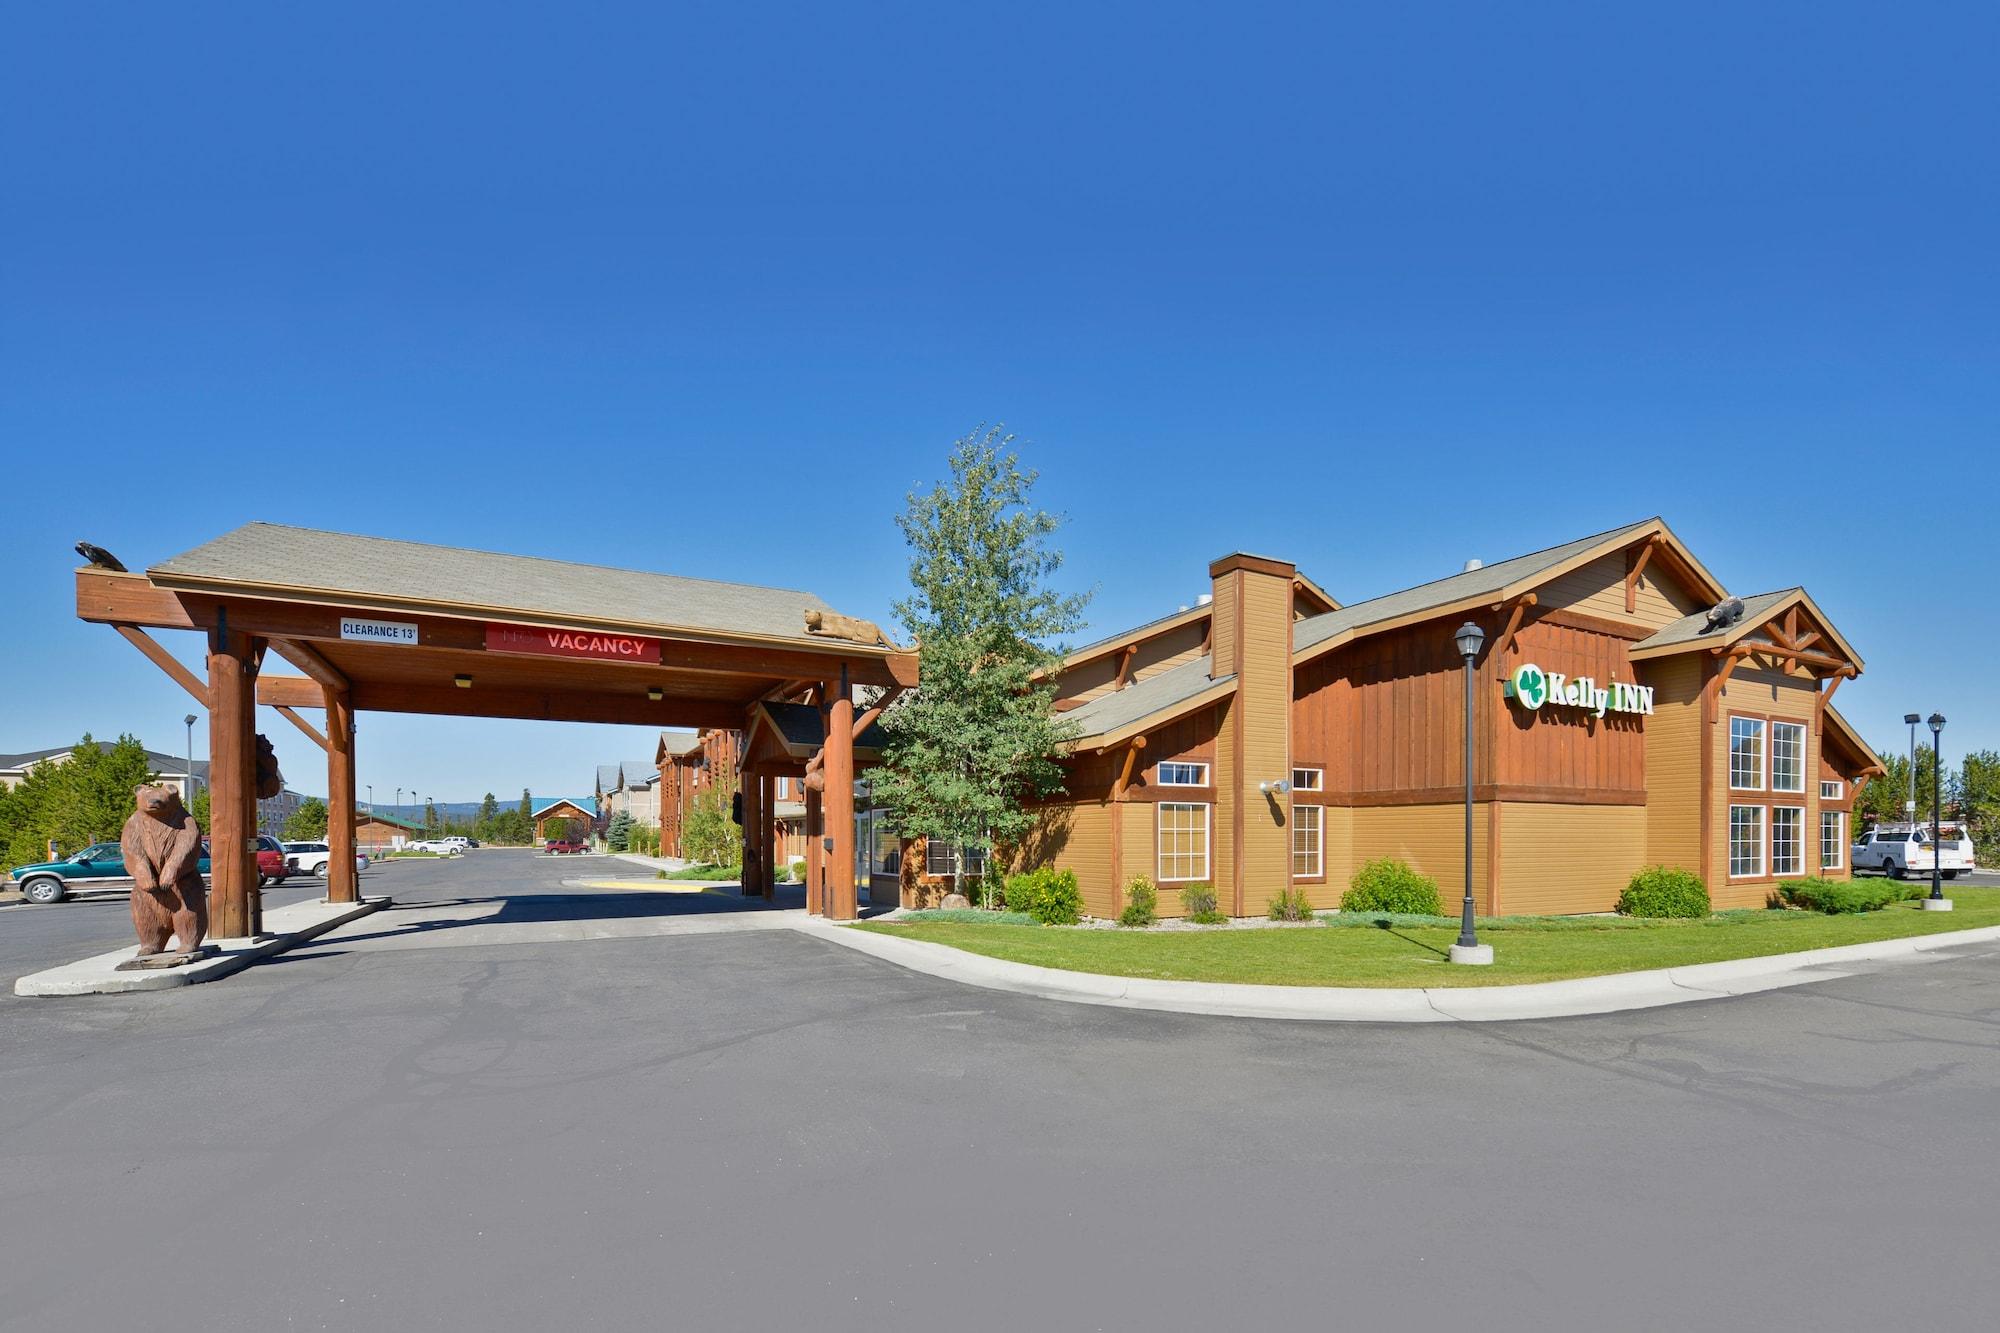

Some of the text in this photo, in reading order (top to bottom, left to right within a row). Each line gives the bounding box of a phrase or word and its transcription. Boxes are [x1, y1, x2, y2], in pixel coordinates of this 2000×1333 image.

[343, 623, 398, 638] CLEARANCE
[547, 633, 645, 655] VACANCY
[1547, 672, 1654, 718] Kelly INN
